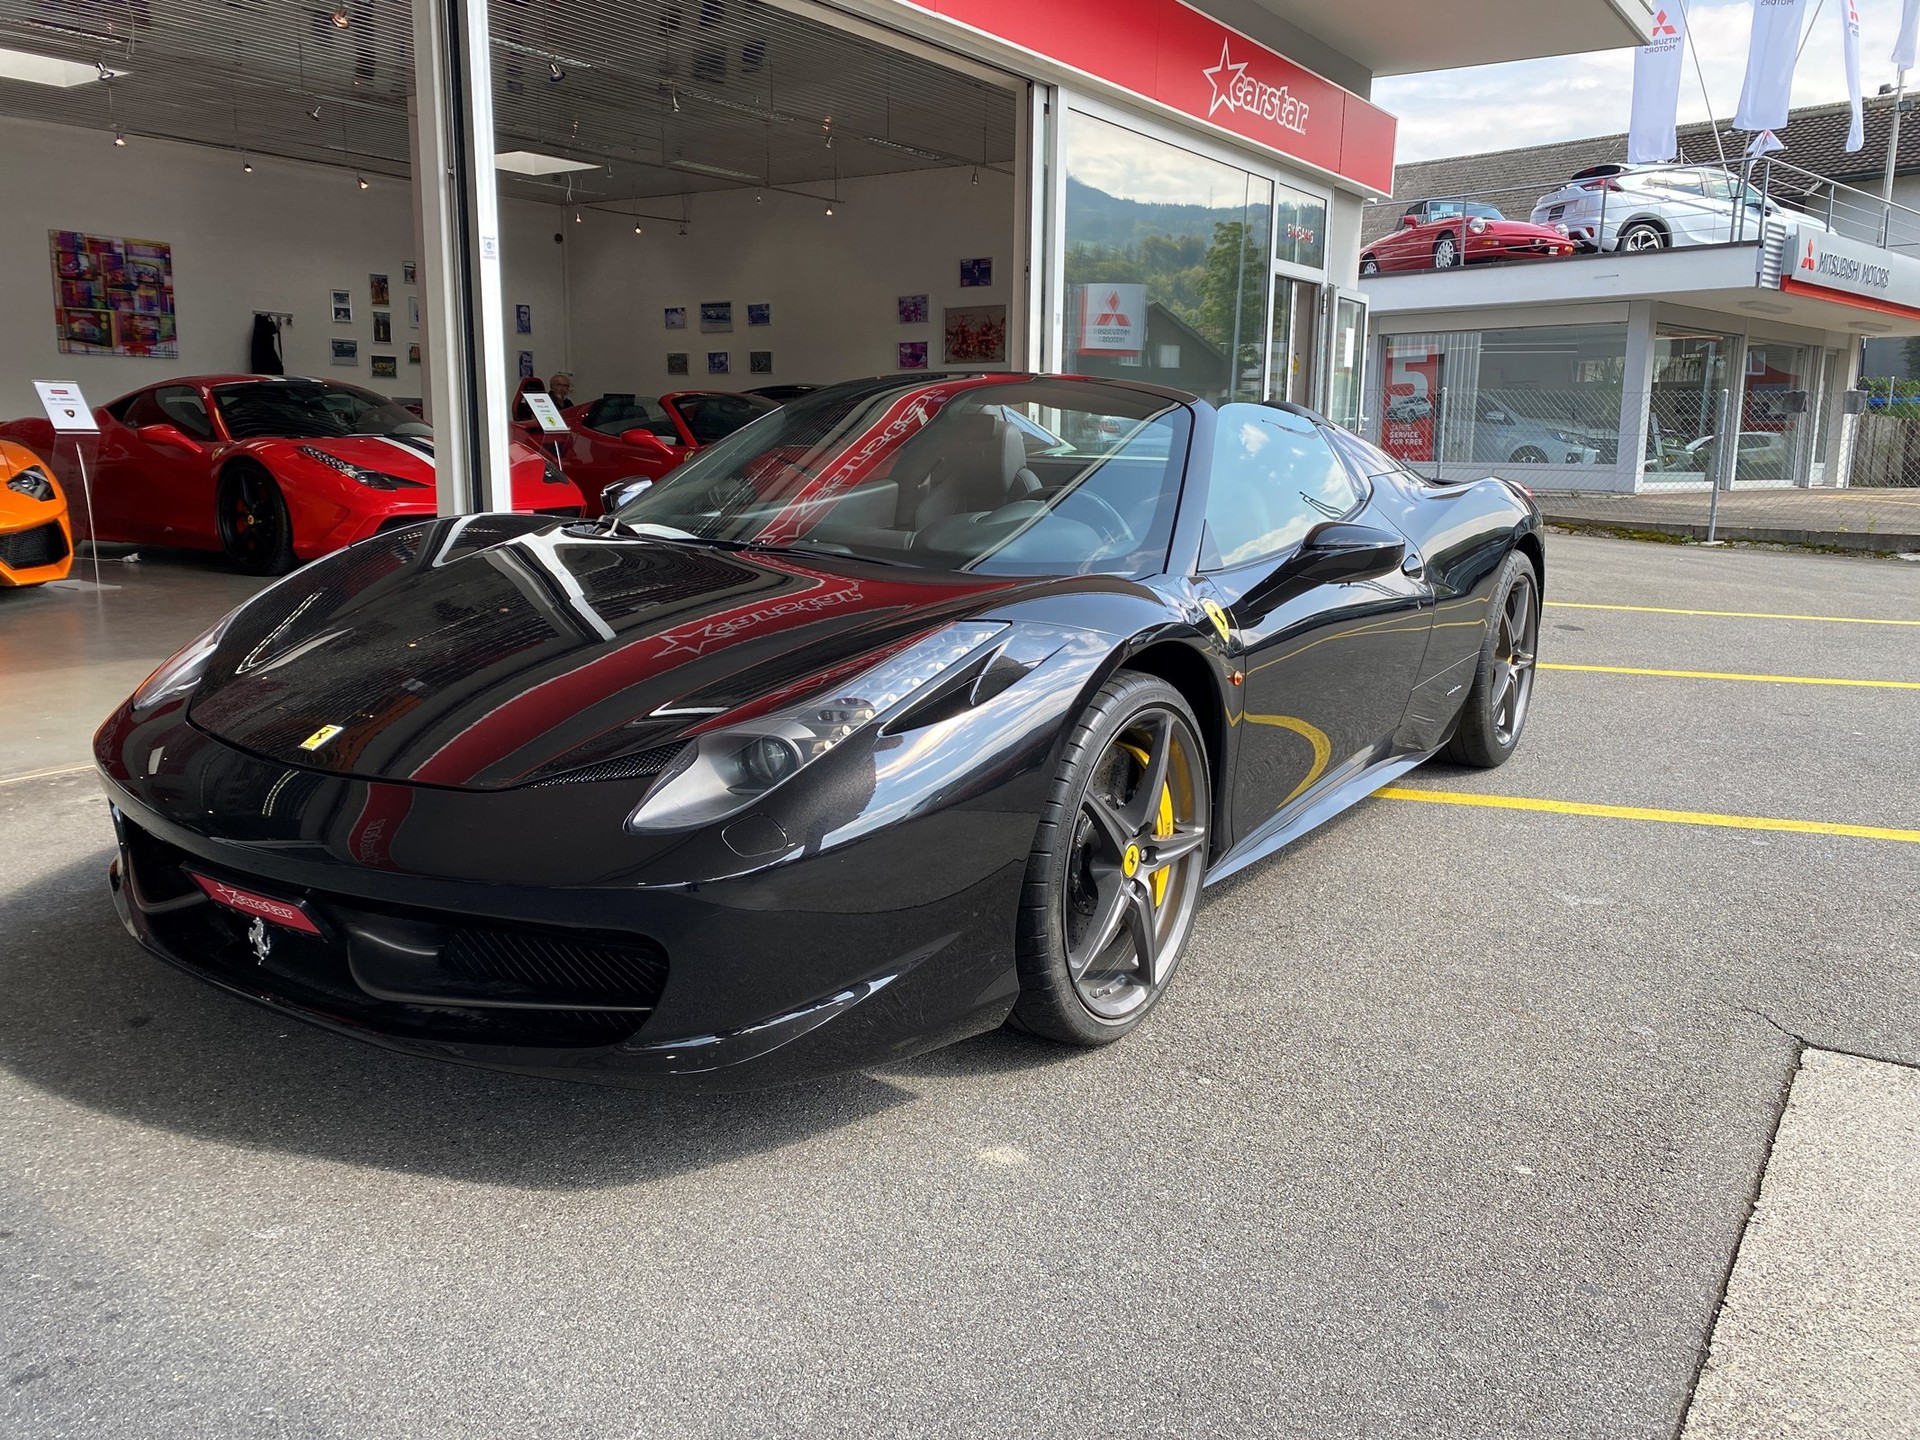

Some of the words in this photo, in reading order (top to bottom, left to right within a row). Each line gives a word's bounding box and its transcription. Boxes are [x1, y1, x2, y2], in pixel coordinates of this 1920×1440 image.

[1231, 72, 1309, 134] carstar
[1817, 252, 1861, 281] MITSUBISHI
[1860, 263, 1890, 289] MOTORS
[1387, 348, 1429, 404] 5
[1389, 431, 1419, 439] SERVICE
[1405, 438, 1423, 446] FREE
[232, 894, 293, 919] carstar
